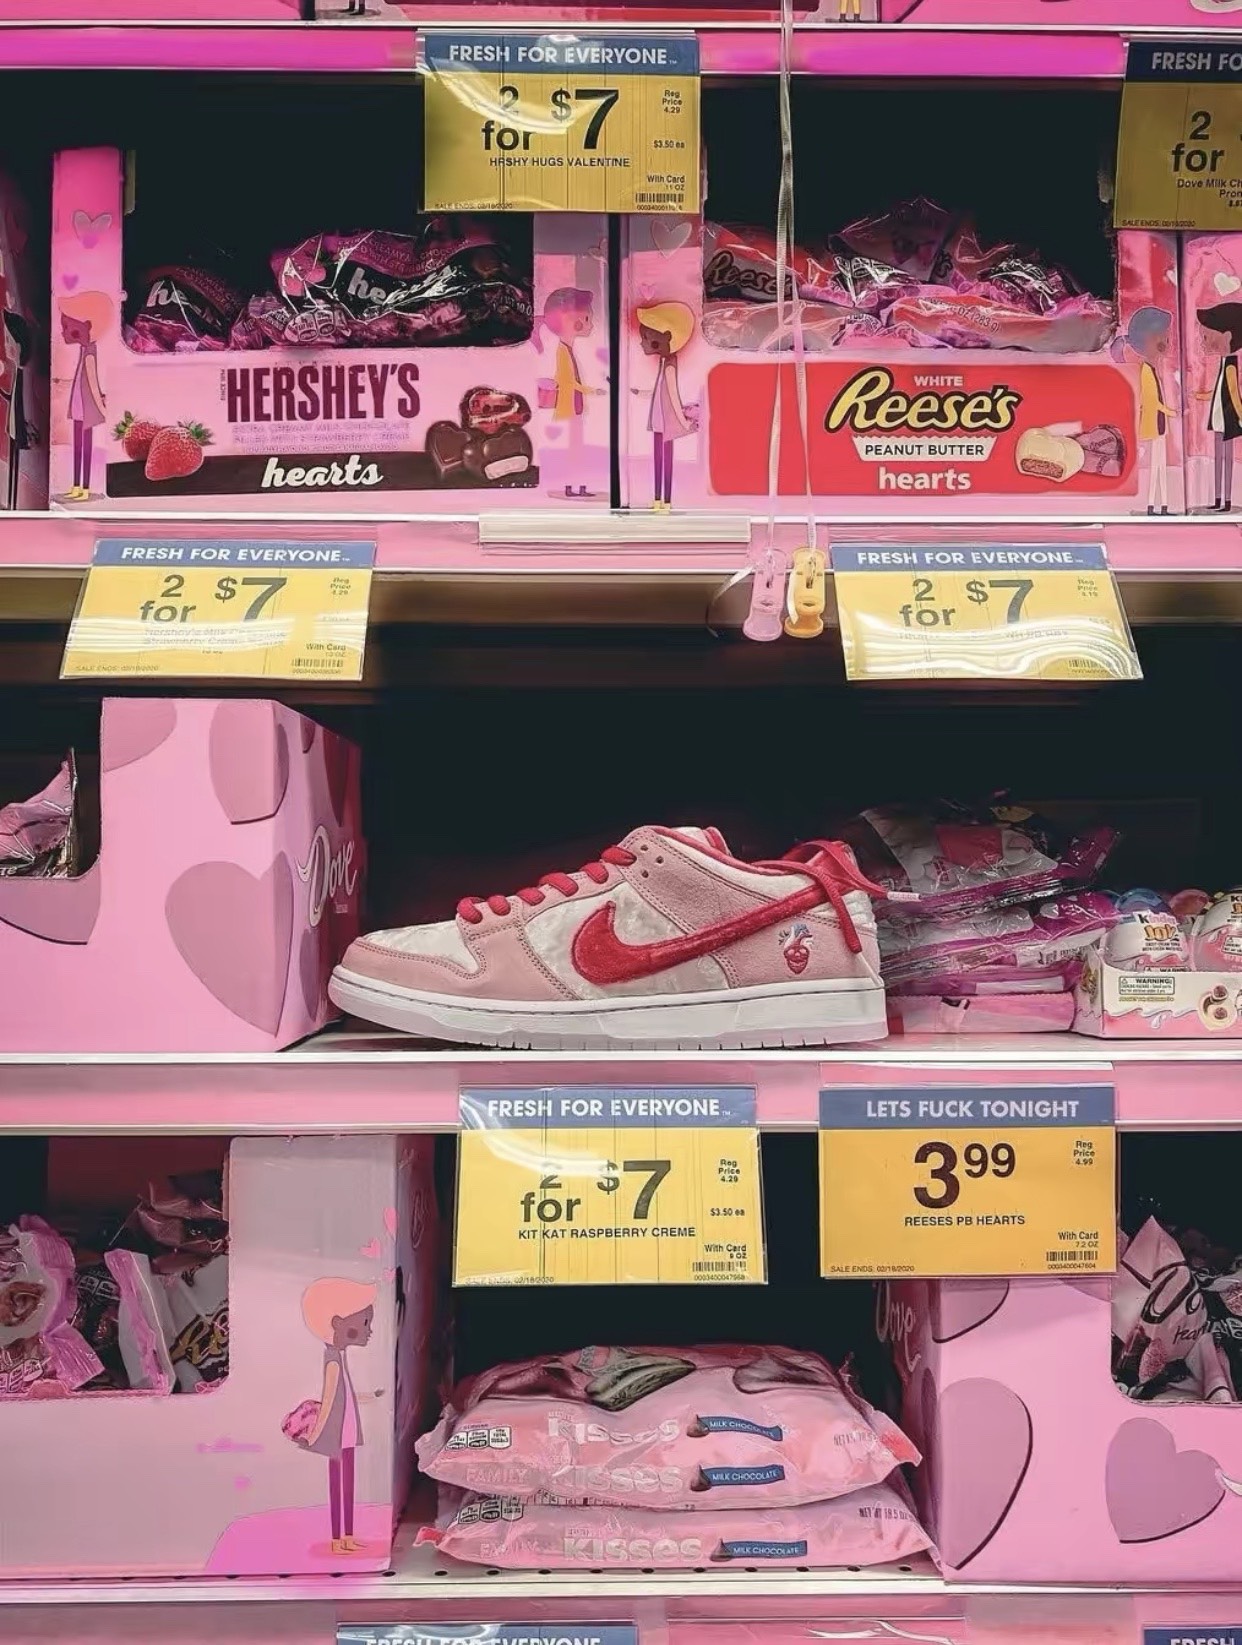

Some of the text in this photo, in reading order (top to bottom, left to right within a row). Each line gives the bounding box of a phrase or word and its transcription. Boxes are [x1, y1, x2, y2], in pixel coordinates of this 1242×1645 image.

[450, 45, 667, 64] FRESH FOR EVERYONE
[1152, 52, 1211, 71] FRESH
[662, 98, 682, 106] Price
[1189, 111, 1211, 140] 2
[481, 120, 536, 151] for
[653, 140, 674, 149] $3.50
[532, 157, 563, 167] HUGS
[567, 157, 630, 168] VALENTINE
[1171, 143, 1225, 172] for
[647, 175, 685, 184] With Card
[1177, 178, 1203, 188] Dove
[1206, 178, 1226, 188] Milk
[914, 375, 963, 387] WHITE
[227, 362, 421, 423] HERSHEY'S
[826, 368, 1022, 432] Reese's
[864, 444, 984, 456] PEANUT BUTTER
[261, 455, 384, 488] hearts
[878, 467, 971, 490] hearts
[121, 547, 342, 562] FRESH FOR EVERYONE
[857, 551, 1073, 565] FRESH FOR EVERYONE
[160, 574, 185, 598] 2
[912, 578, 935, 601] 2
[140, 600, 196, 623] for
[899, 604, 956, 627] for
[306, 643, 346, 651] With Card
[488, 1099, 720, 1116] FRESH FOR EVERYONE
[867, 1100, 1079, 1118] LETS FUCK TONIGHT
[1075, 1141, 1093, 1150] Reg
[1073, 1149, 1095, 1157] Price
[720, 1159, 737, 1168] Reg
[1075, 1158, 1093, 1166] 4.99
[718, 1167, 740, 1175] Price
[720, 1175, 738, 1183] 4.29
[520, 1192, 581, 1223] for
[710, 1208, 731, 1217] $3.50
[904, 1215, 1025, 1226] REESES PB HEARTS
[519, 1227, 695, 1239] KIT KAT RASPBERRY CREME
[1058, 1231, 1099, 1240] With Card
[704, 1243, 746, 1252] With Card
[709, 1420, 727, 1428] MILK
[712, 1470, 778, 1481] MILK CHOCOLATE
[733, 1546, 799, 1555] MILK CHOCOLATE
